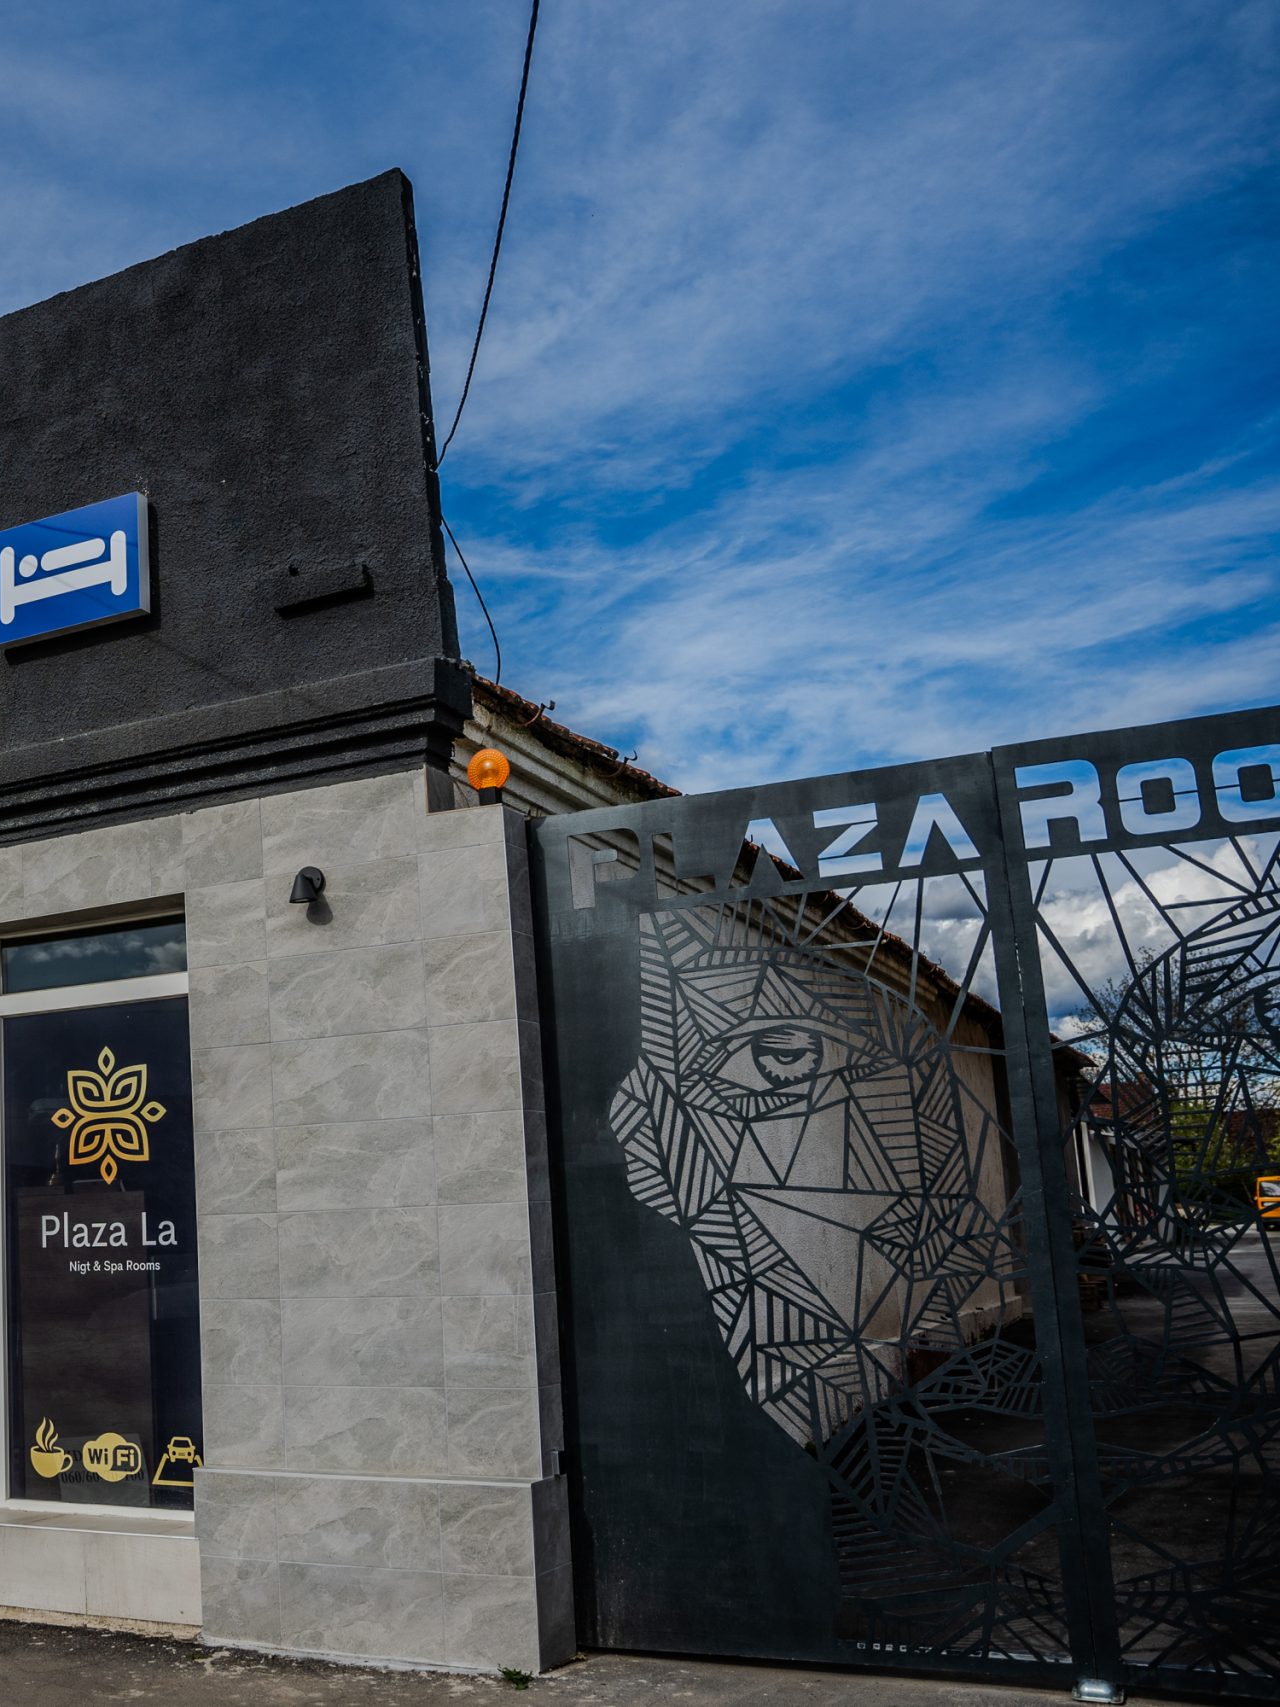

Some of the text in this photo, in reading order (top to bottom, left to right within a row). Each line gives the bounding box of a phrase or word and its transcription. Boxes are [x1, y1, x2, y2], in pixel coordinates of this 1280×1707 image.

[566, 792, 981, 910] PLAZA
[41, 1211, 178, 1248] Plaza La
[69, 1260, 161, 1274] Nigt & Spa Rooms
